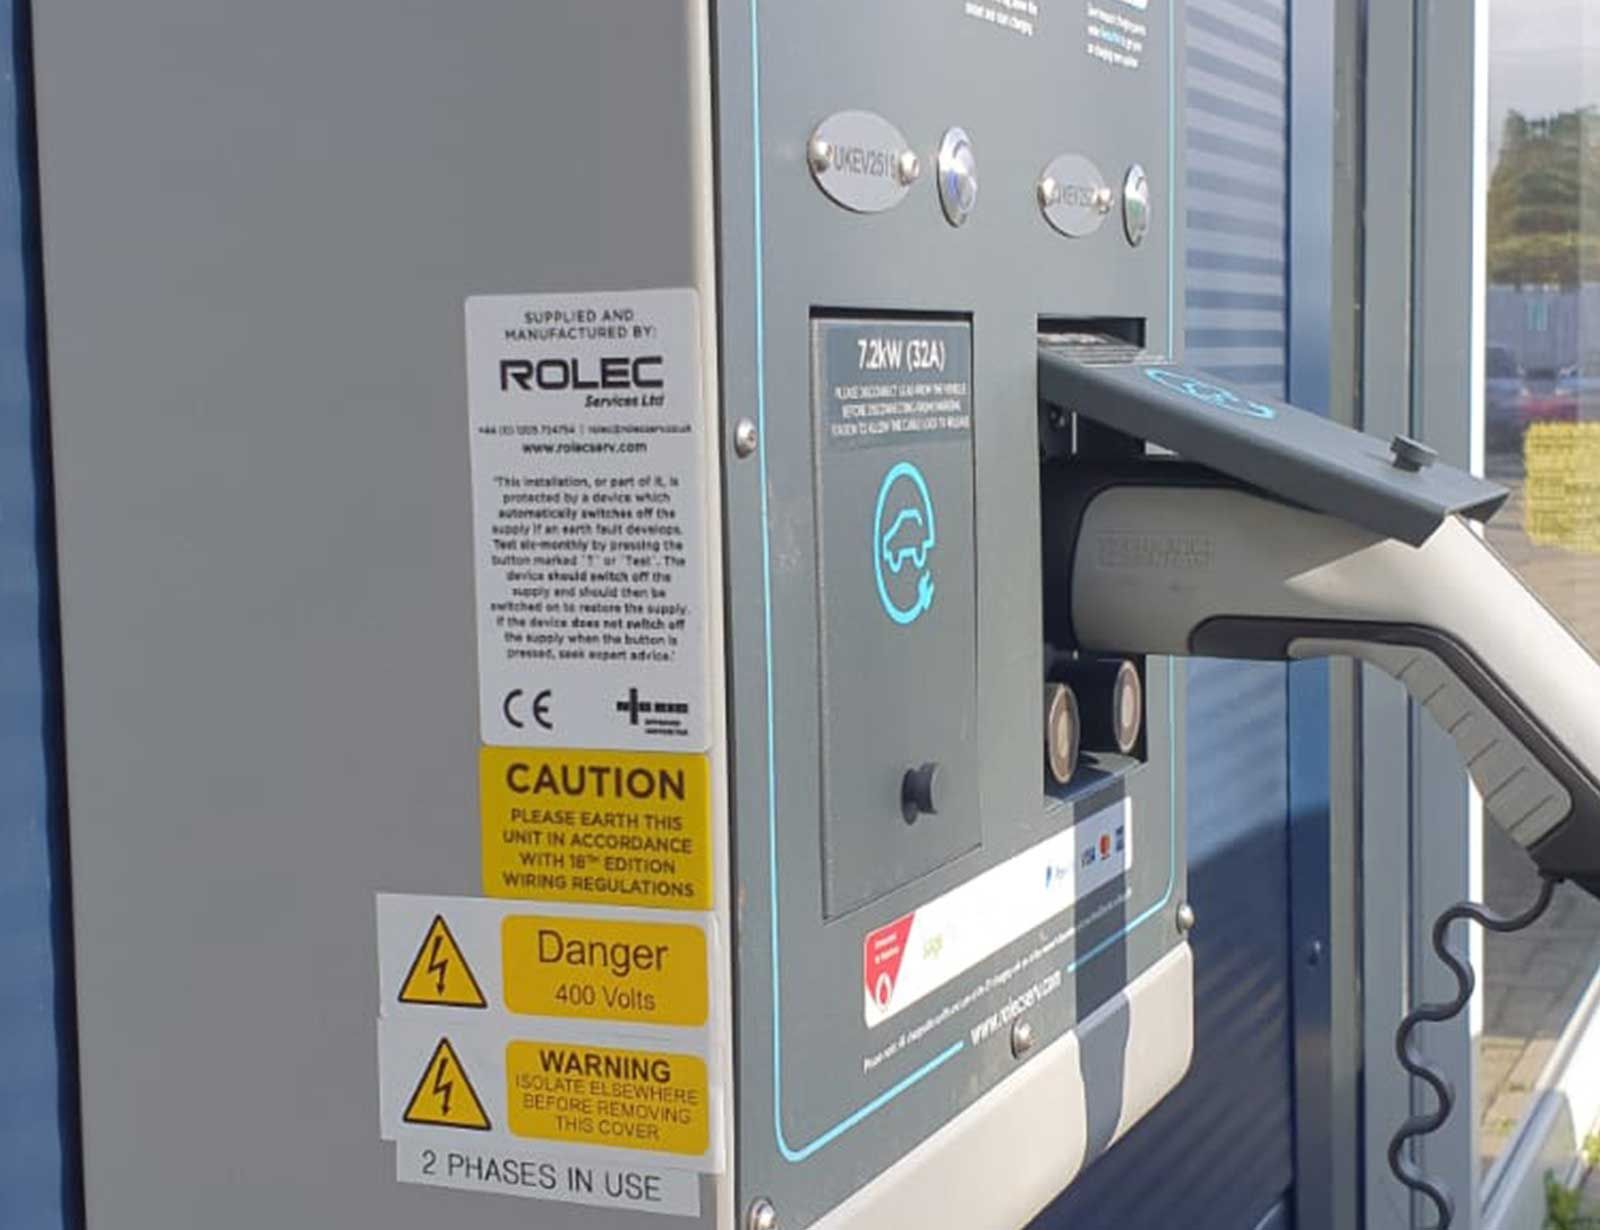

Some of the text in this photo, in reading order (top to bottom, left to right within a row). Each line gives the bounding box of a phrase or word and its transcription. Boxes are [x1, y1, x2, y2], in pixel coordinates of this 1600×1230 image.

[524, 310, 634, 324] SUPPLIED AND
[505, 325, 657, 340] MANUFACTURED BY:
[858, 338, 945, 372] 7.2kW (32A)
[500, 355, 663, 391] ROLEC
[585, 394, 664, 408] Services Ltd
[522, 441, 648, 455] www.rolecserv.com
[610, 478, 634, 489] part
[638, 476, 651, 487] of
[503, 493, 671, 505] protected by a device which
[499, 508, 676, 520] automatically switches off the
[492, 524, 530, 536] supply
[532, 524, 542, 535] if
[545, 526, 558, 535] an
[562, 524, 592, 535] earth
[596, 524, 622, 535] fault
[492, 539, 683, 552] Test six-monthly by pressing the
[492, 554, 530, 566] button
[534, 554, 578, 566] marked
[604, 556, 616, 566] or
[664, 555, 686, 566] The
[506, 572, 671, 582] device should switch off the
[512, 588, 666, 599] supply and should then be
[490, 602, 542, 613] switched
[546, 604, 560, 613] on
[564, 603, 576, 613] to
[579, 603, 622, 614] restore
[624, 603, 644, 614] the
[508, 617, 526, 628] the
[530, 617, 568, 628] device
[571, 618, 600, 628] does
[604, 618, 622, 629] not
[626, 618, 665, 630] switch
[668, 618, 686, 630] off
[504, 632, 678, 646] the supply when the button is
[507, 649, 556, 661] pressed,
[559, 650, 585, 660] seek
[588, 650, 627, 662] expert
[506, 763, 685, 800] CAUTION
[511, 808, 682, 830] PLEASE EARTH THIS
[503, 830, 692, 854] UNIT IN ACCORDANCE
[520, 852, 564, 868] WITH
[604, 856, 676, 874] EDITION
[503, 873, 694, 897] WIRING REGULATIONS
[538, 930, 668, 977] Danger
[554, 984, 656, 1011] 400 Volts
[540, 1050, 671, 1083] WARNING
[516, 1074, 698, 1106] ISOLATE ELSEWHERE
[523, 1094, 691, 1124] BEFORE REMOVING
[556, 1116, 660, 1140] THIS COVER
[422, 1150, 662, 1202] 2 PHASES IN USE
